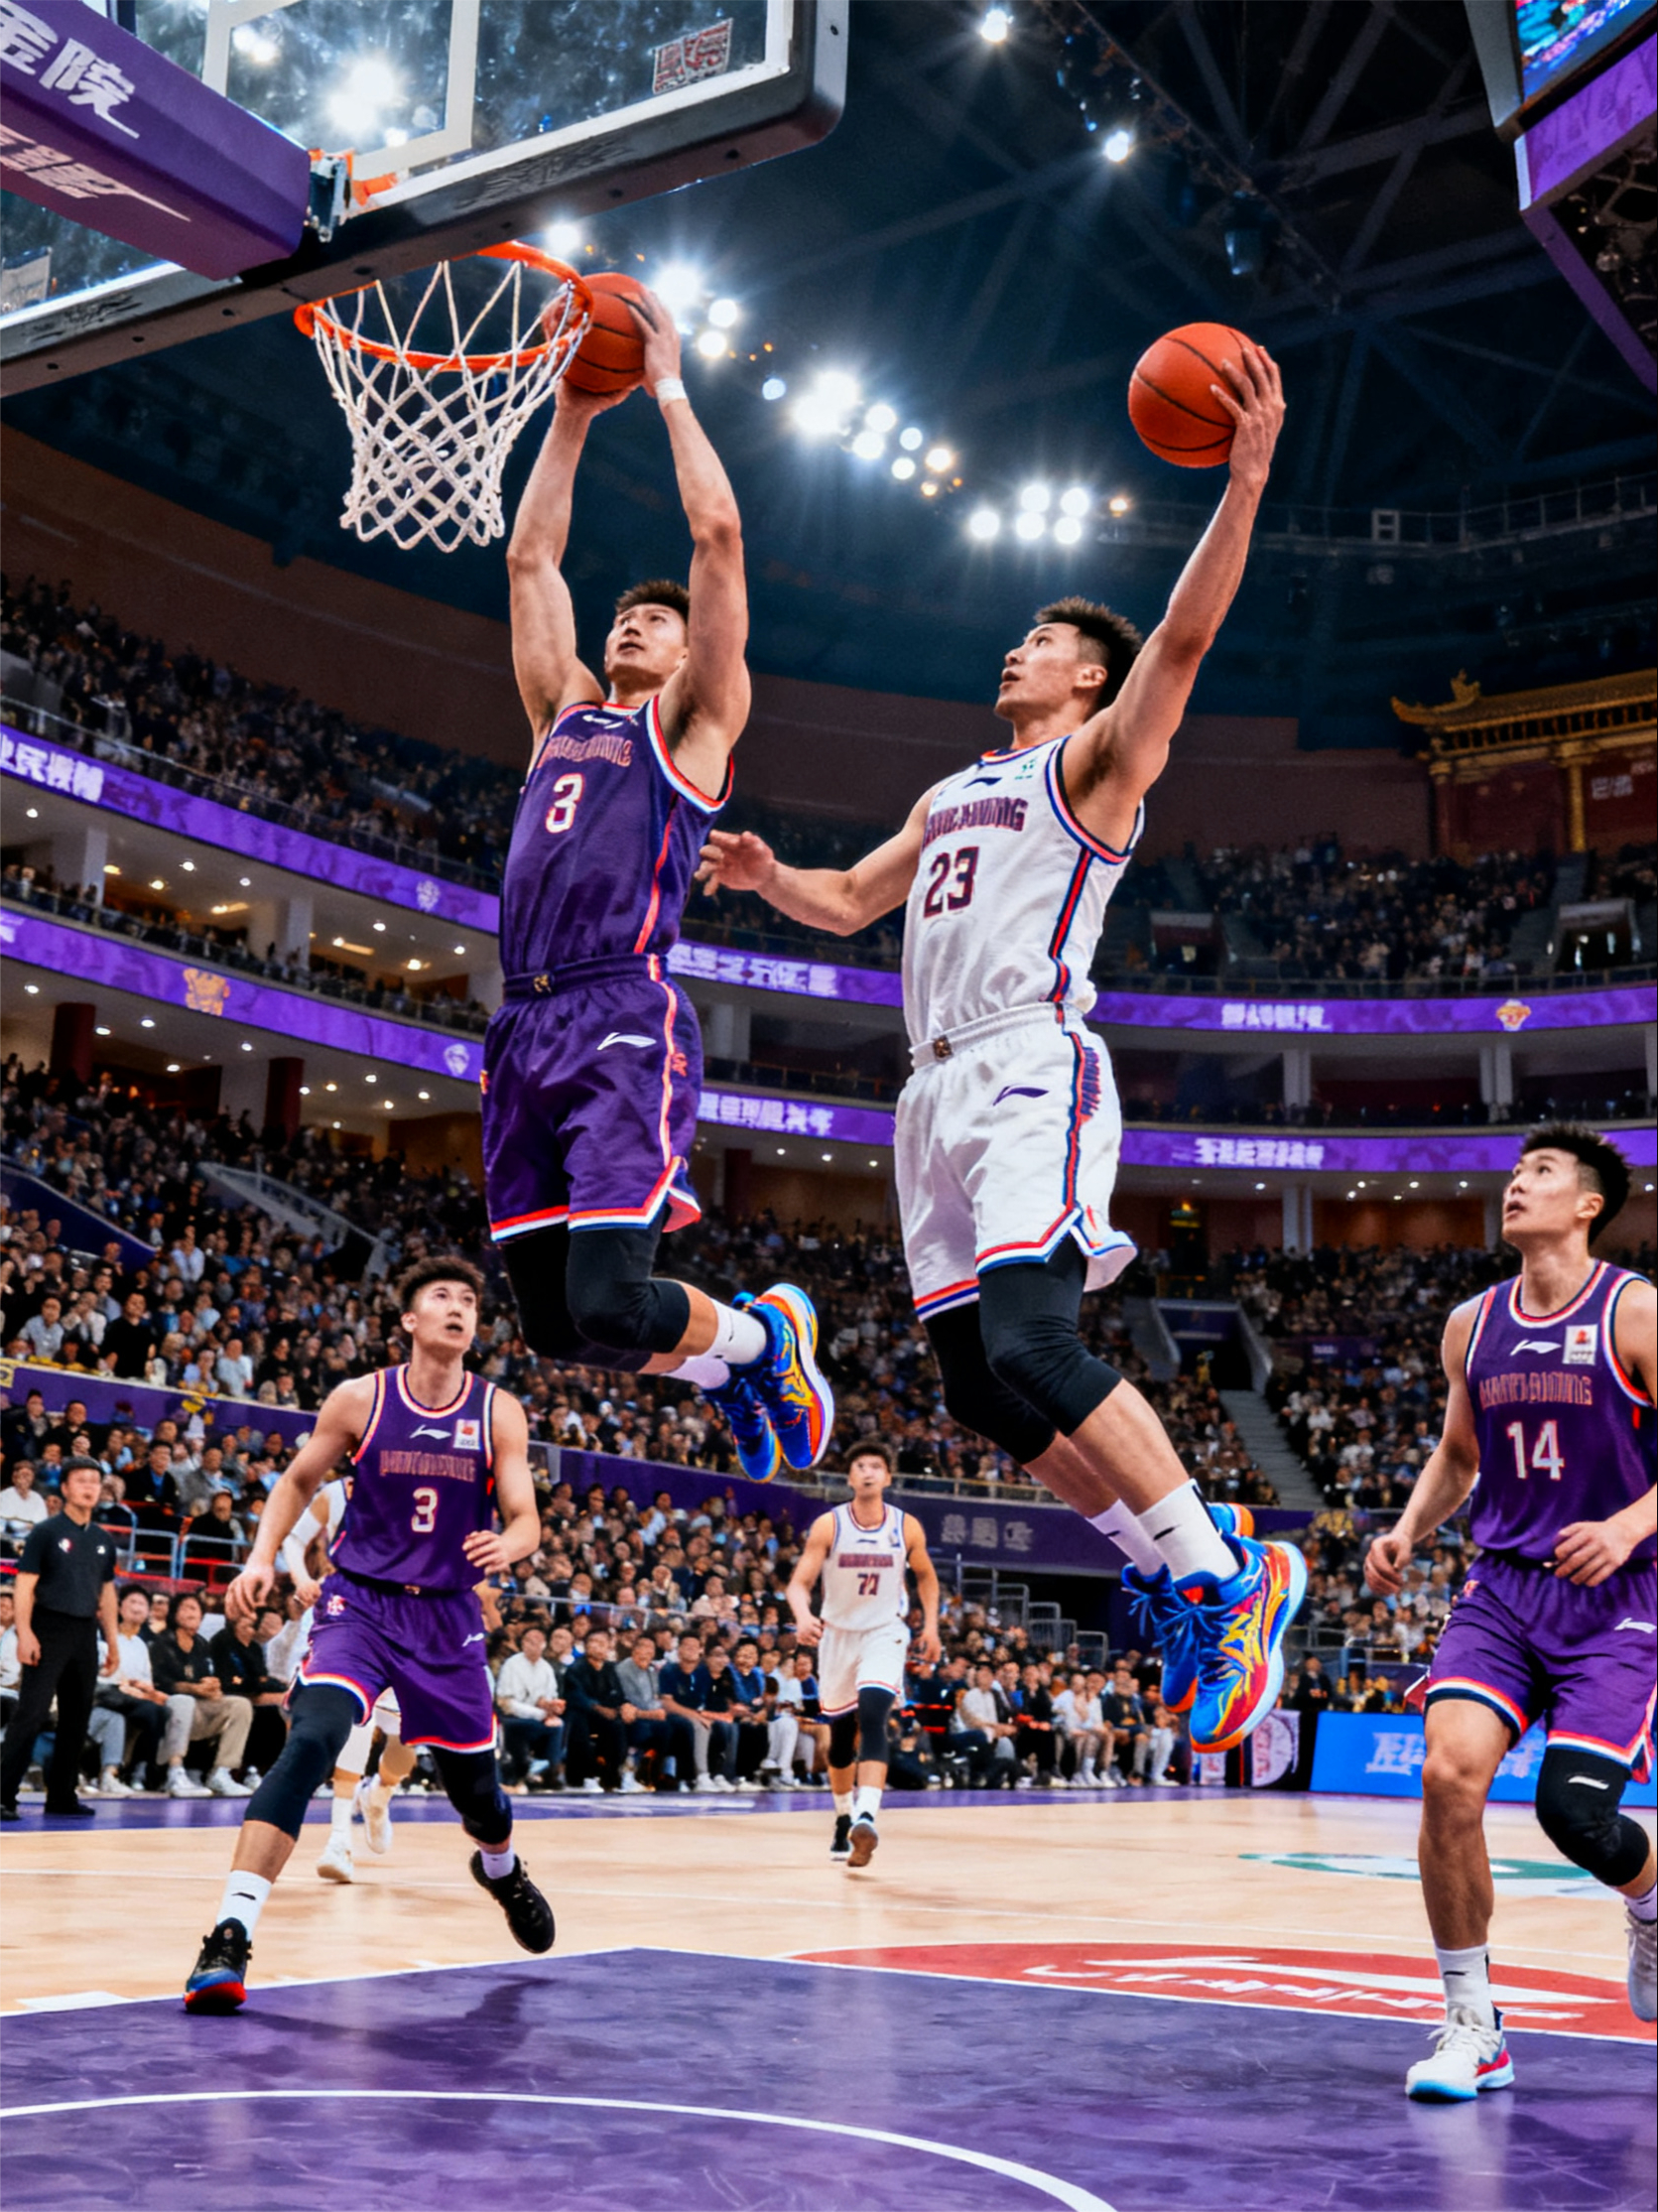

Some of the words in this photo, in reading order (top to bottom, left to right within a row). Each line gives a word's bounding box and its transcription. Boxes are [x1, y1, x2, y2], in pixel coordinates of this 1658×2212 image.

[545, 772, 583, 834] 3
[924, 846, 979, 919] 23
[1507, 1419, 1565, 1481] 14
[411, 1487, 438, 1533] 3
